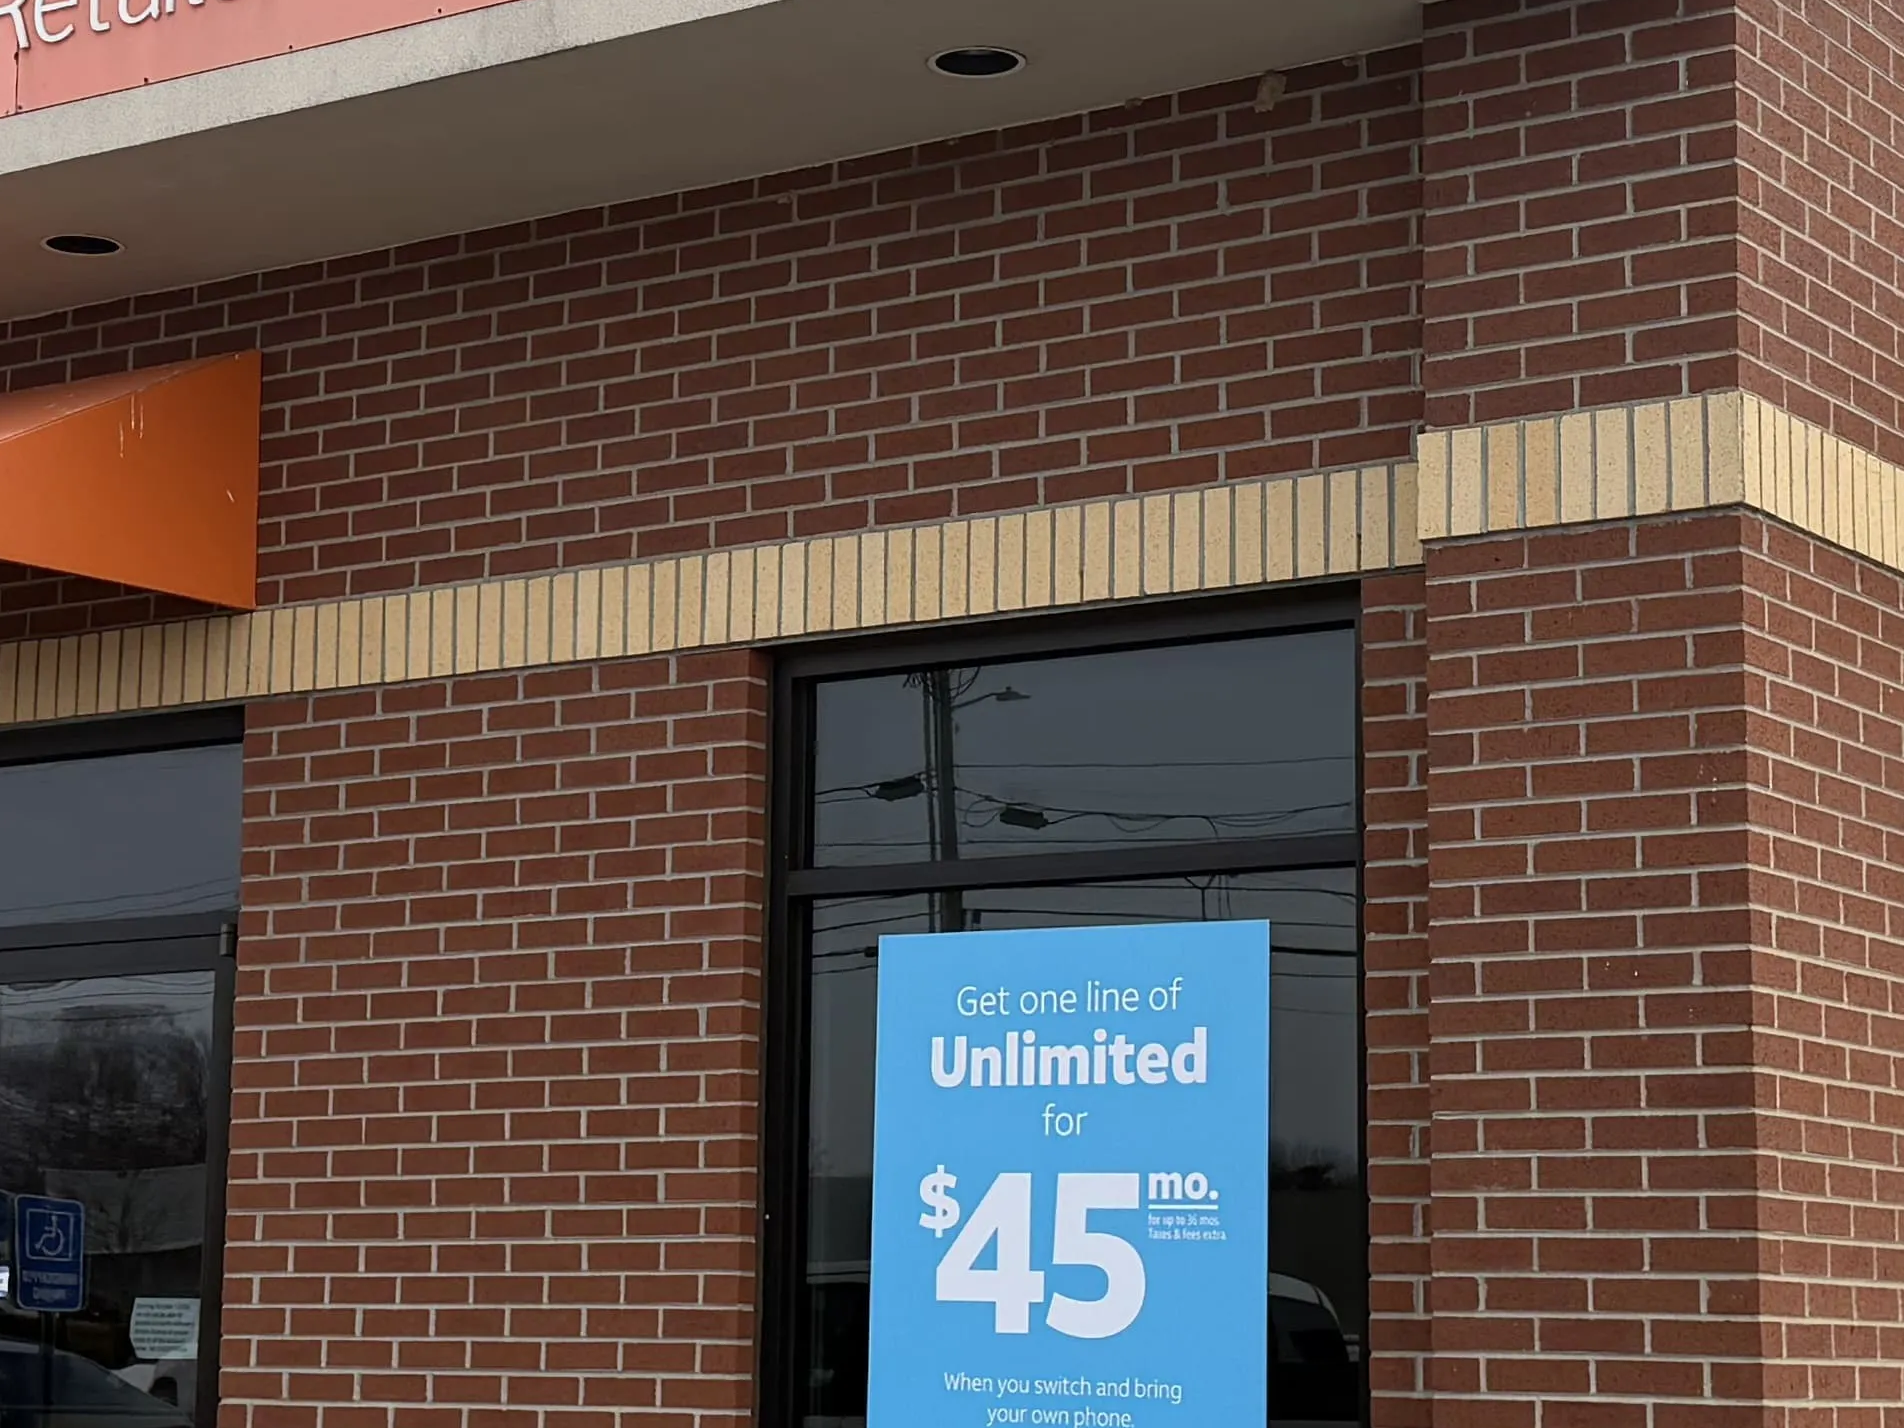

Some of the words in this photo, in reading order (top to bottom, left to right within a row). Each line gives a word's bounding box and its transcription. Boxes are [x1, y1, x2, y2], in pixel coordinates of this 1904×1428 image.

[957, 986, 1010, 1016] Get
[1019, 990, 1077, 1014] one
[1086, 980, 1140, 1012] line
[1149, 976, 1184, 1011] of
[930, 1026, 1208, 1088] Unlimited
[1041, 1103, 1089, 1136] for
[1147, 1171, 1220, 1201] mo.
[943, 1371, 994, 1393] When
[997, 1377, 1030, 1399] you
[1034, 1375, 1092, 1396] switch
[1095, 1377, 1130, 1398] and
[1134, 1378, 1184, 1405] bring
[986, 1407, 1028, 1428] your
[1031, 1408, 1070, 1425] own
